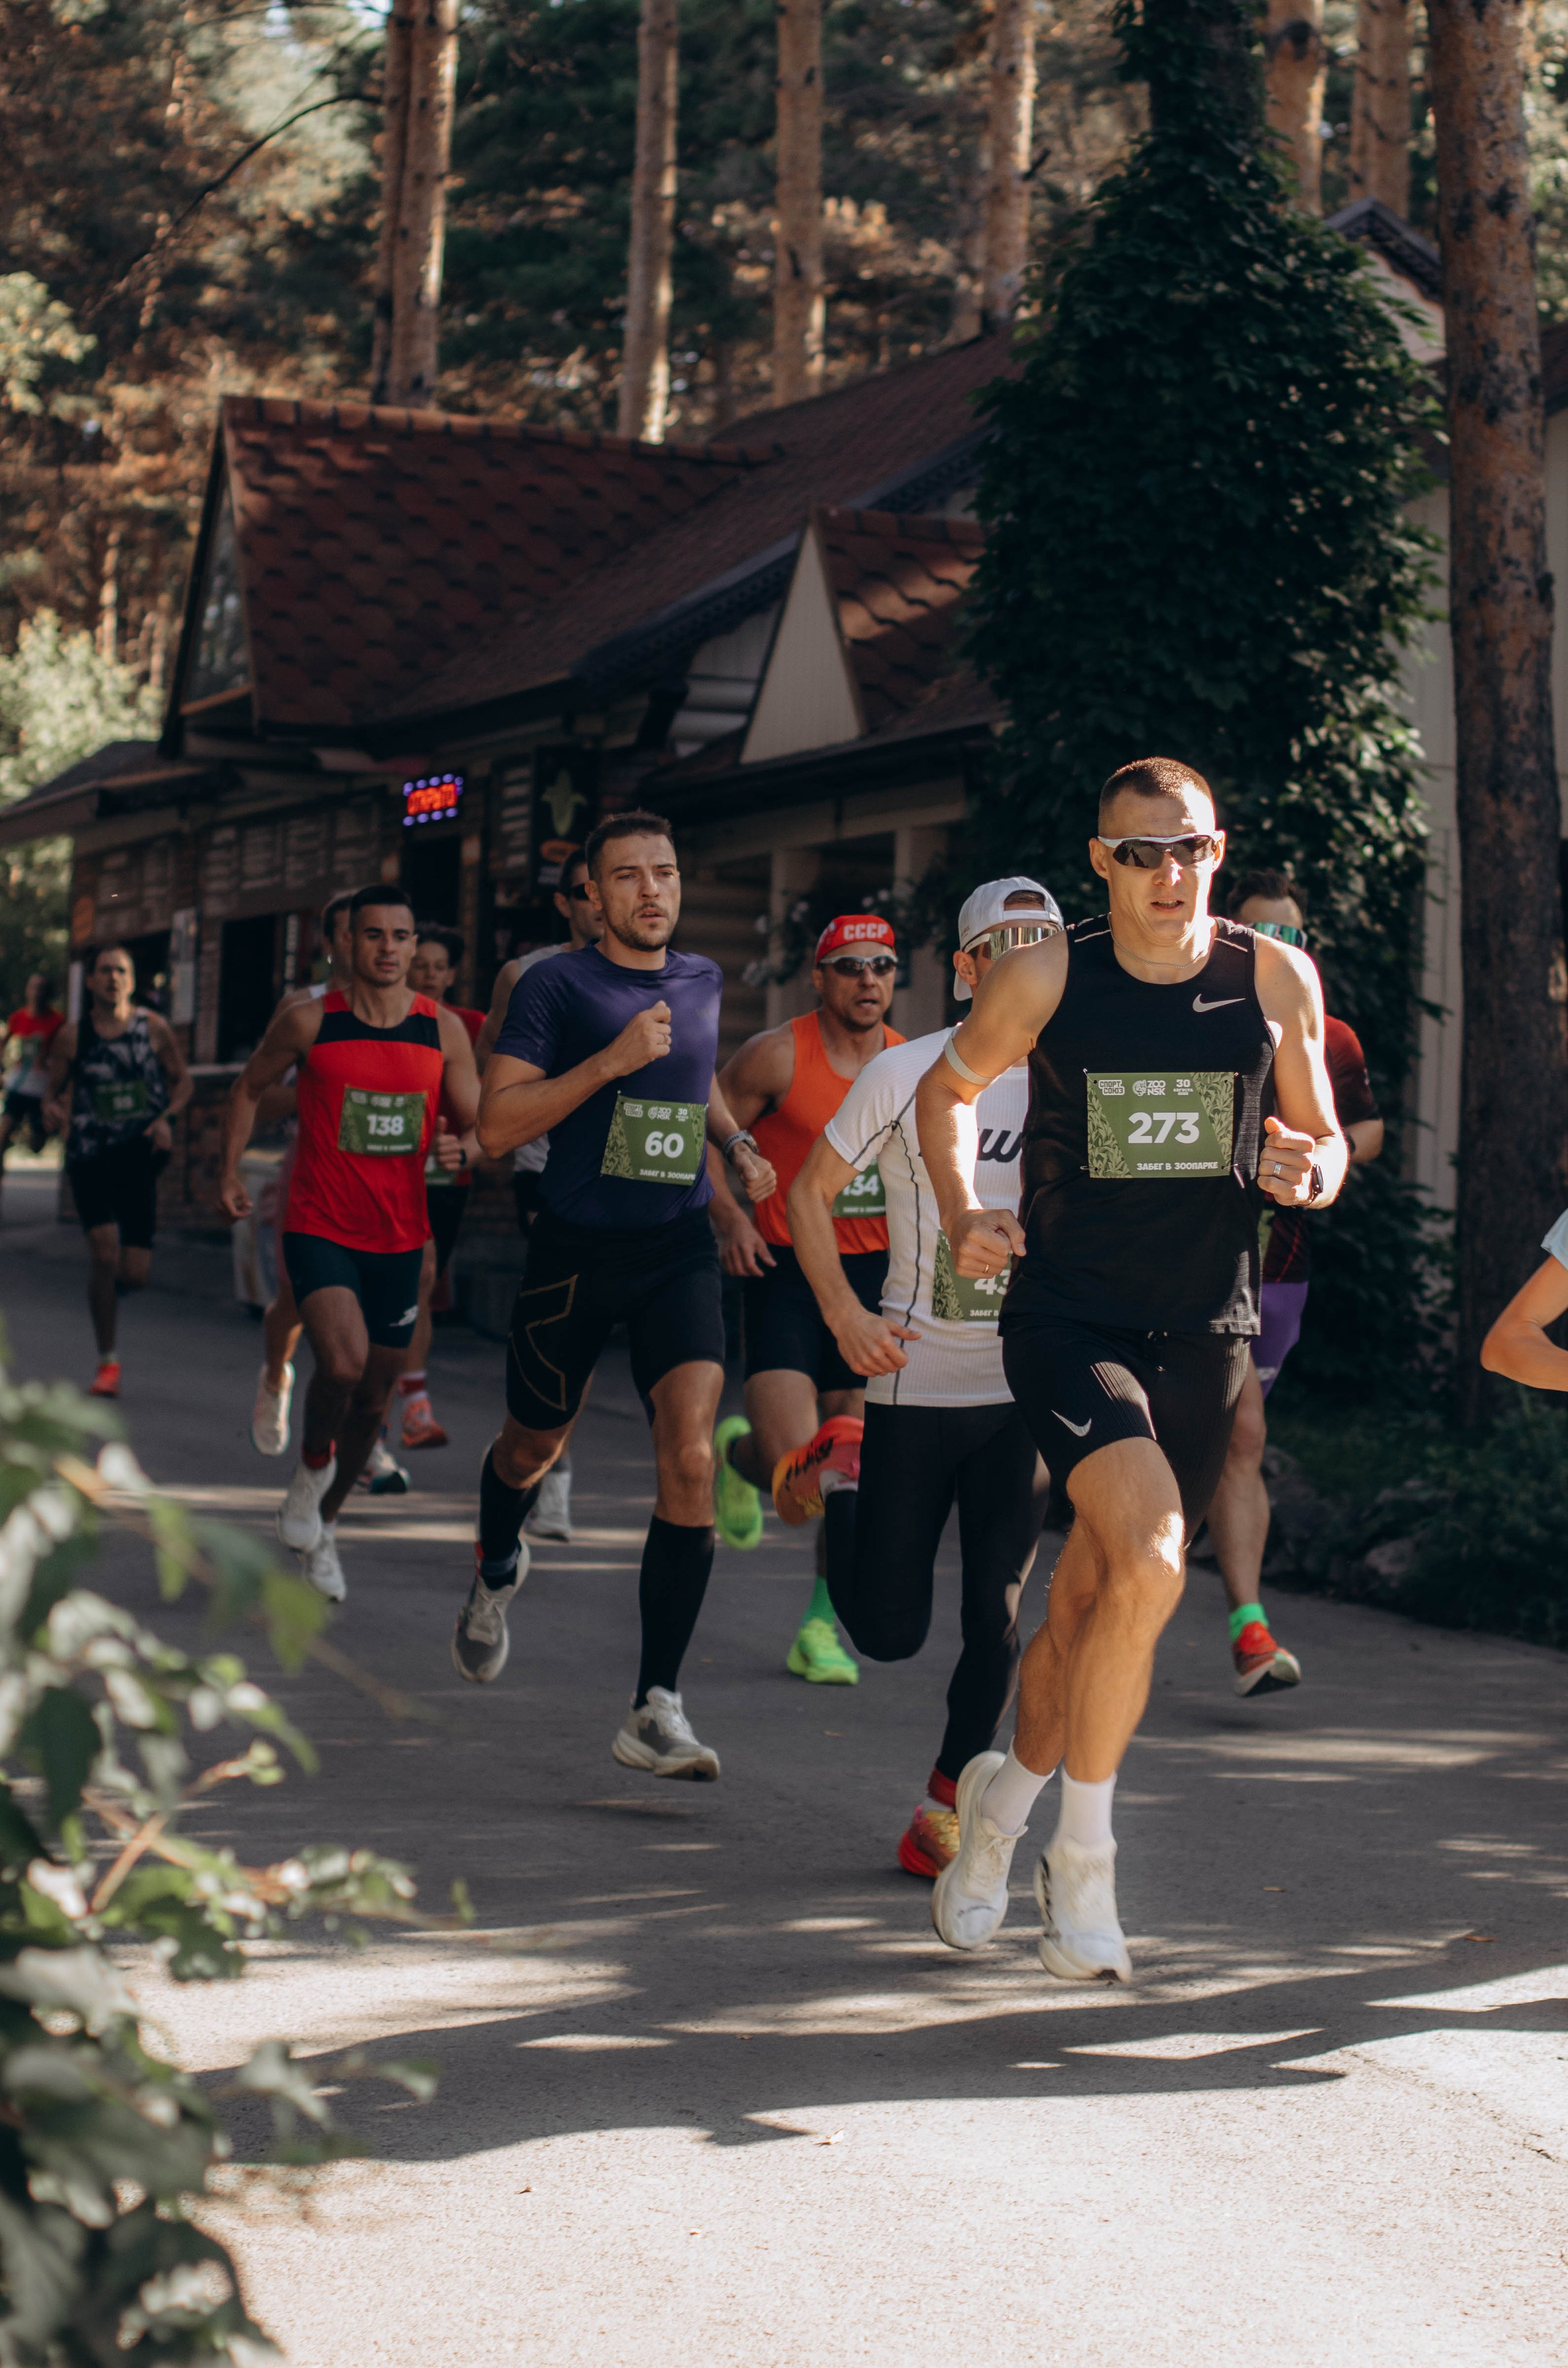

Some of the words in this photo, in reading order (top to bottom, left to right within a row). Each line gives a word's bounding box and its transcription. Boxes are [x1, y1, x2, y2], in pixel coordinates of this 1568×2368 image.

[843, 923, 889, 940] СССР
[1176, 1079, 1190, 1088] 30
[367, 1114, 404, 1136] 138
[1128, 1112, 1200, 1144] 273
[644, 1131, 684, 1158] 60
[1174, 1162, 1218, 1170] ЗООПАРКЕ
